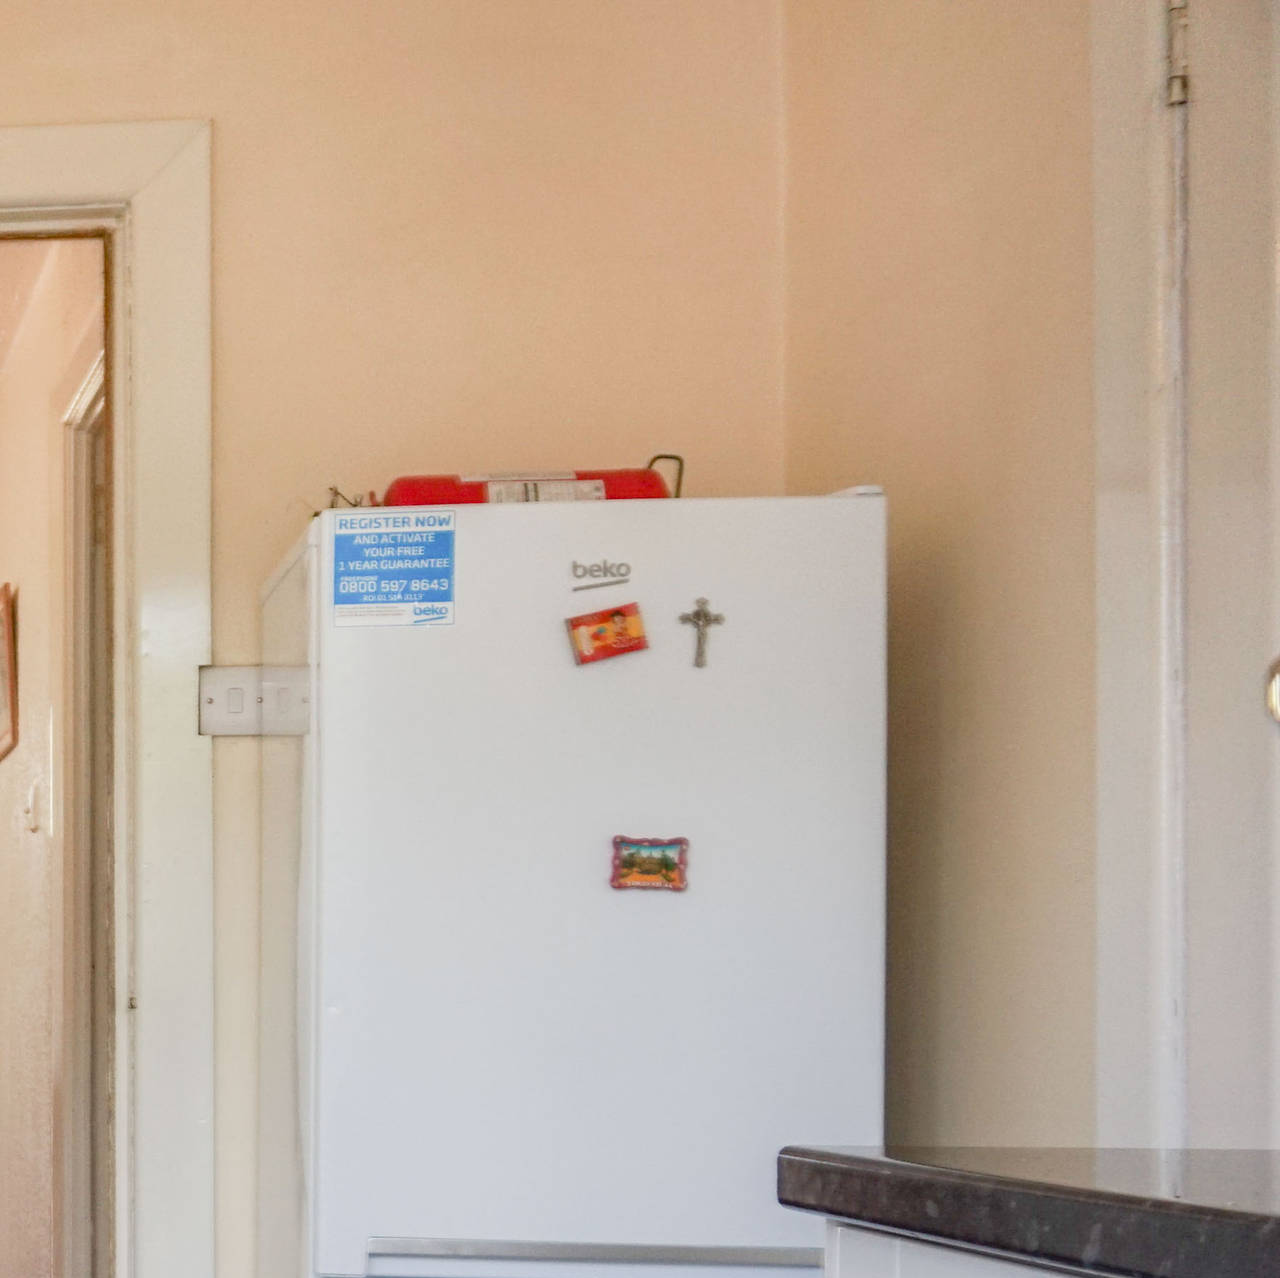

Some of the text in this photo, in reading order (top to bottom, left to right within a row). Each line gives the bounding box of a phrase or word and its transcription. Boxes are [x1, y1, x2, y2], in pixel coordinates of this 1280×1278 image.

[338, 514, 451, 530] REGISTER NOW
[353, 532, 436, 545] AND ACTIVATE
[363, 546, 425, 557] YOUR FREE
[348, 560, 378, 571] YEAR
[380, 558, 450, 570] GUARANTEE
[571, 560, 632, 579] beko
[339, 581, 377, 593] 0800
[410, 578, 449, 591] 8643
[413, 605, 448, 616] beko
